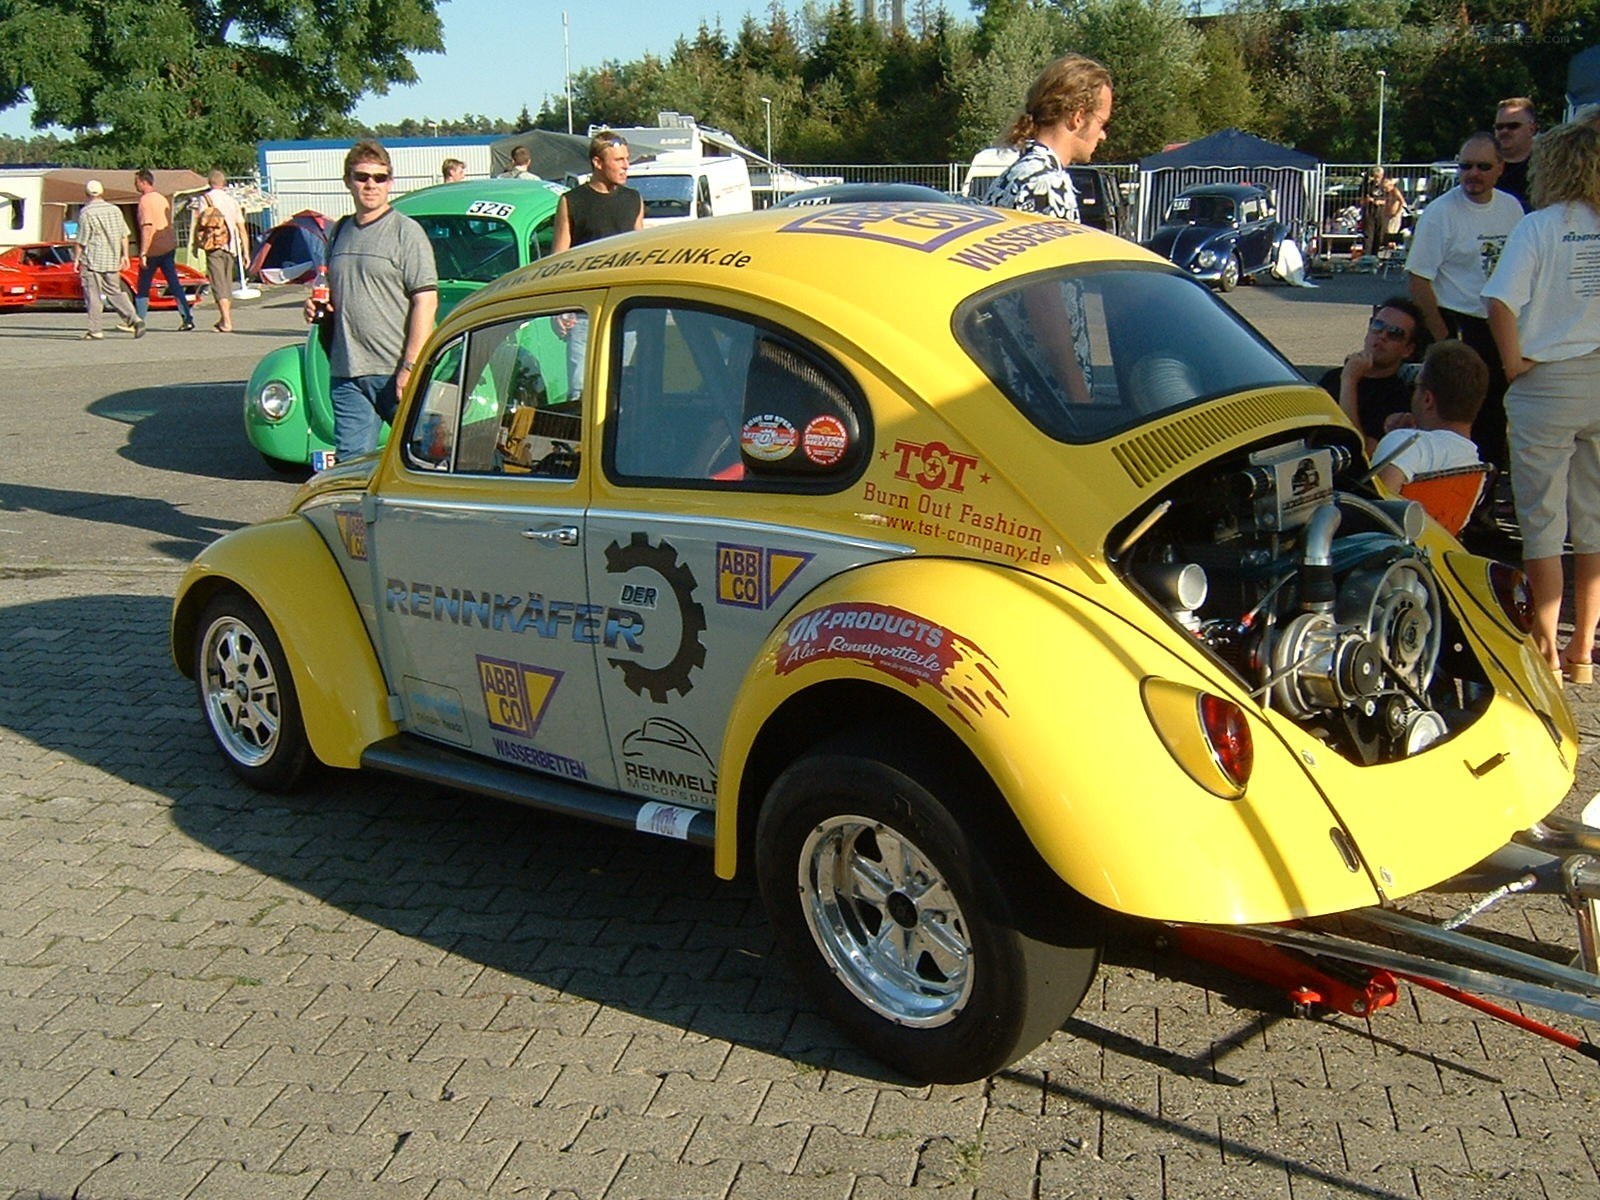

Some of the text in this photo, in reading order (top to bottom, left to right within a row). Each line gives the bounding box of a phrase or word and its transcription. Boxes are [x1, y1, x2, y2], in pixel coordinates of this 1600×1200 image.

[469, 201, 513, 217] 326
[893, 439, 979, 492] TST
[863, 481, 1043, 544] Burn Out Fashion
[870, 513, 1052, 566] www.tst-company.de
[721, 550, 757, 577] ABB
[621, 584, 657, 606] DER
[733, 577, 757, 601] CO
[386, 577, 645, 653] RENNKÄFER
[787, 609, 944, 649] OK-PRODUCTS
[484, 664, 517, 698] ABB
[499, 698, 524, 728] CO
[492, 737, 588, 780] WASSERBETTEN
